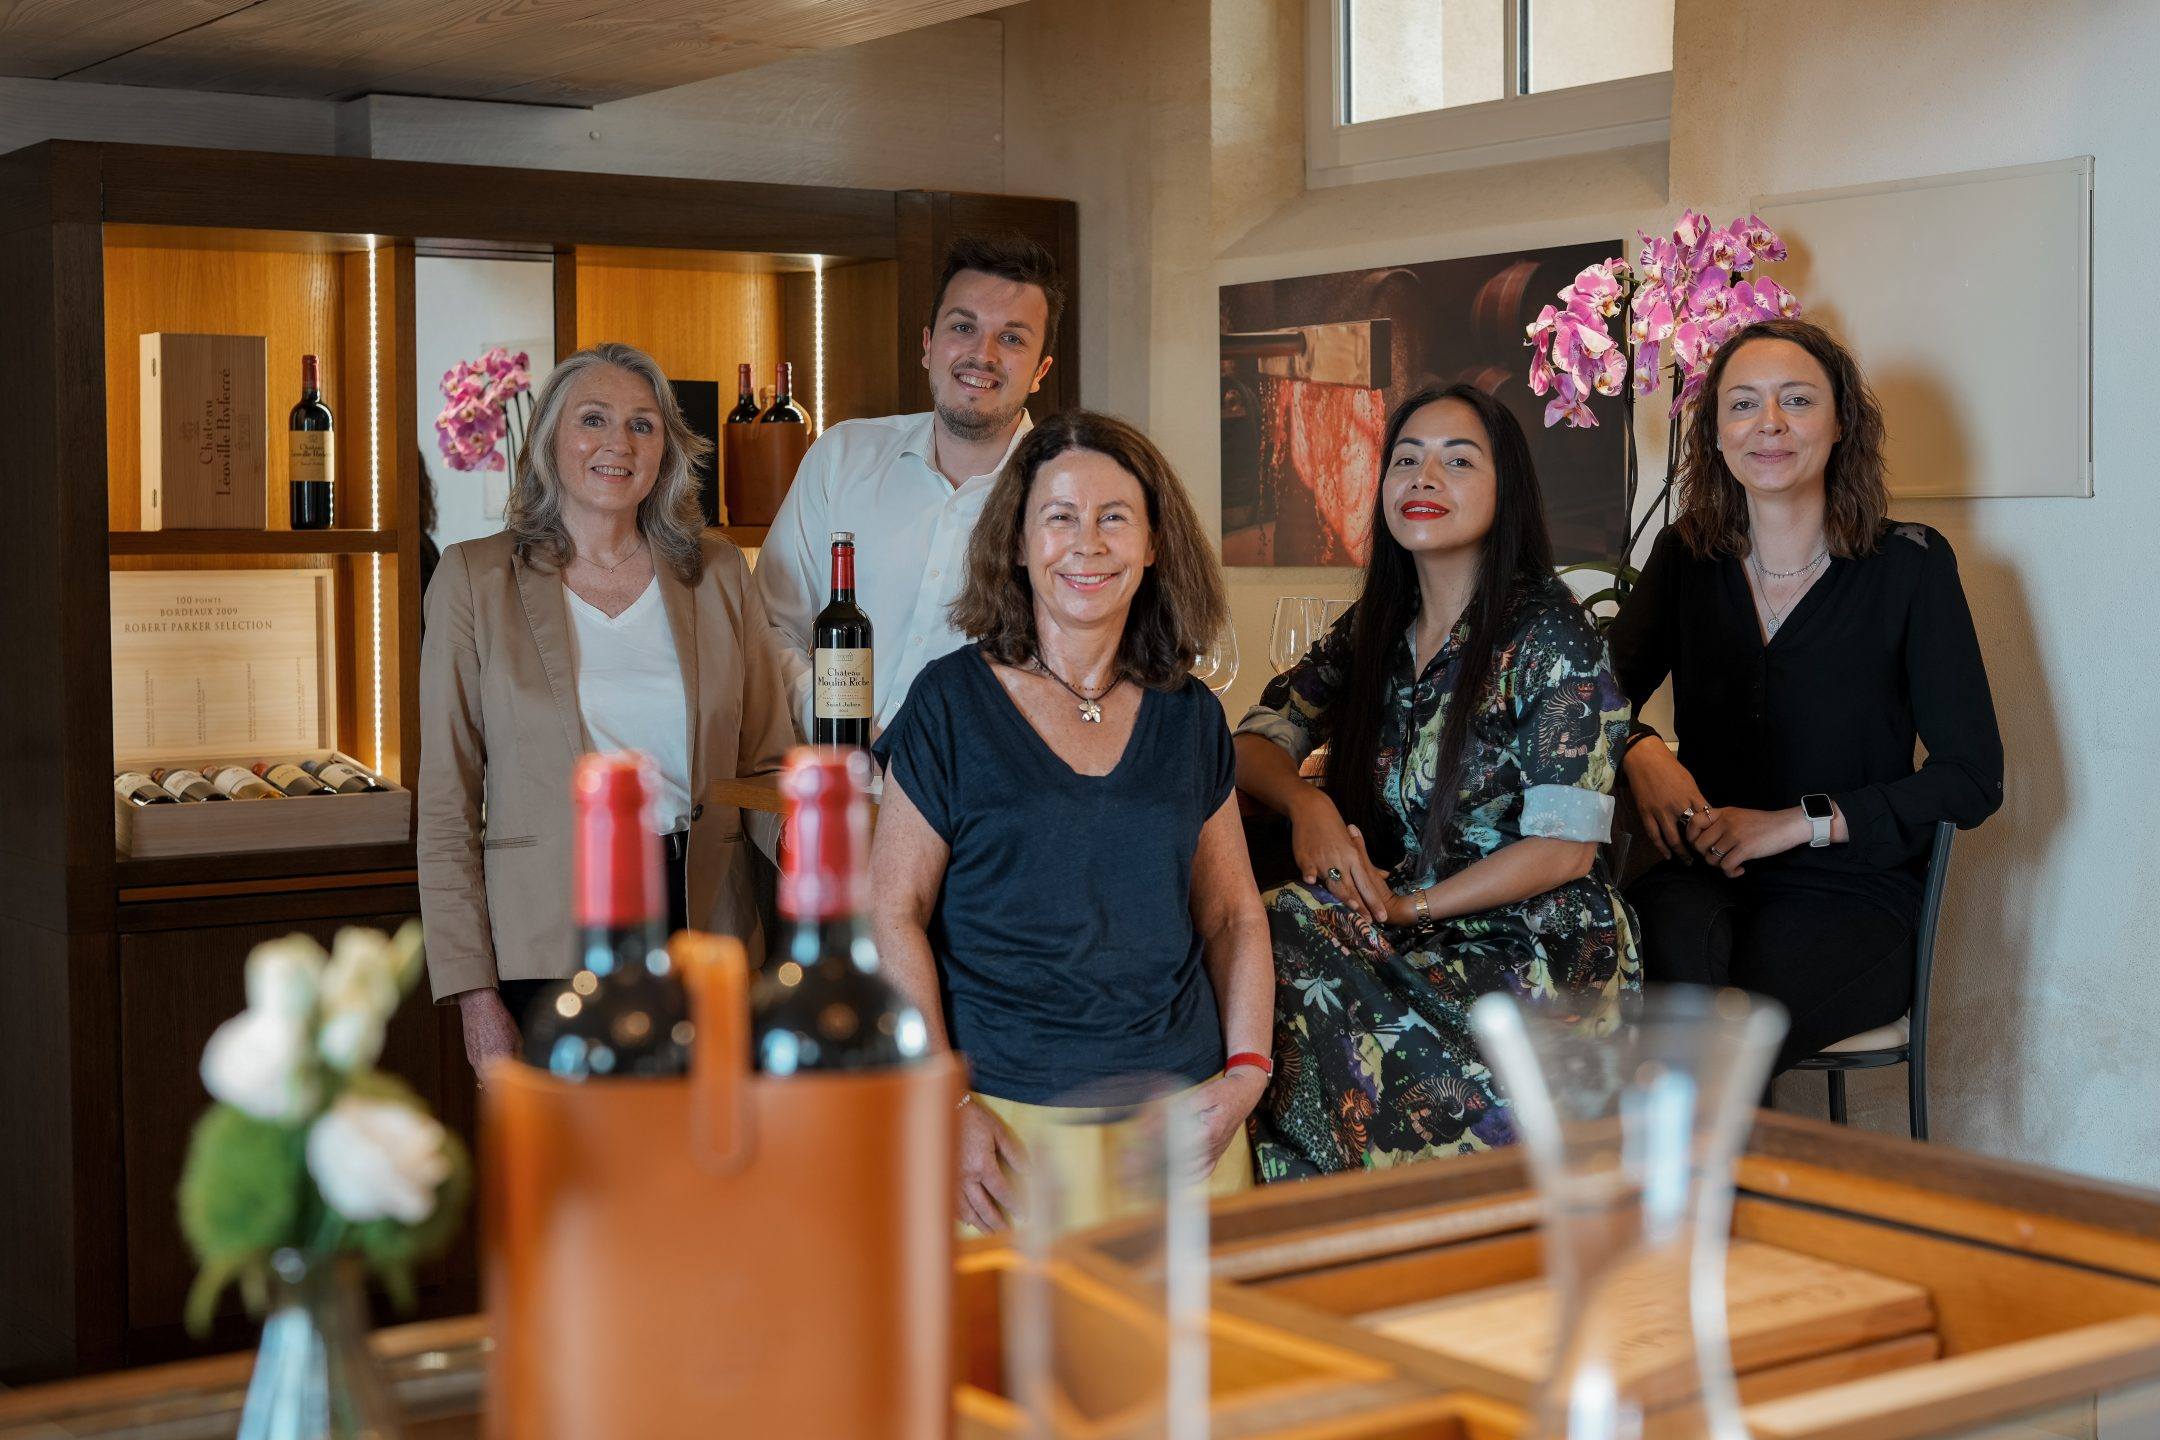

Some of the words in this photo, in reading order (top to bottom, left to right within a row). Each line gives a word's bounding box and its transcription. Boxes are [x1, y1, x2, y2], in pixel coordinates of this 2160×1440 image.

[176, 596, 192, 605] 100
[160, 607, 213, 617] BORDEAUX
[216, 606, 238, 616] 2009
[124, 622, 167, 633] ROBERT
[171, 621, 211, 632] PARKER
[215, 619, 273, 631] SELECTION
[818, 676, 846, 687] Moulin
[849, 676, 871, 687] Riche
